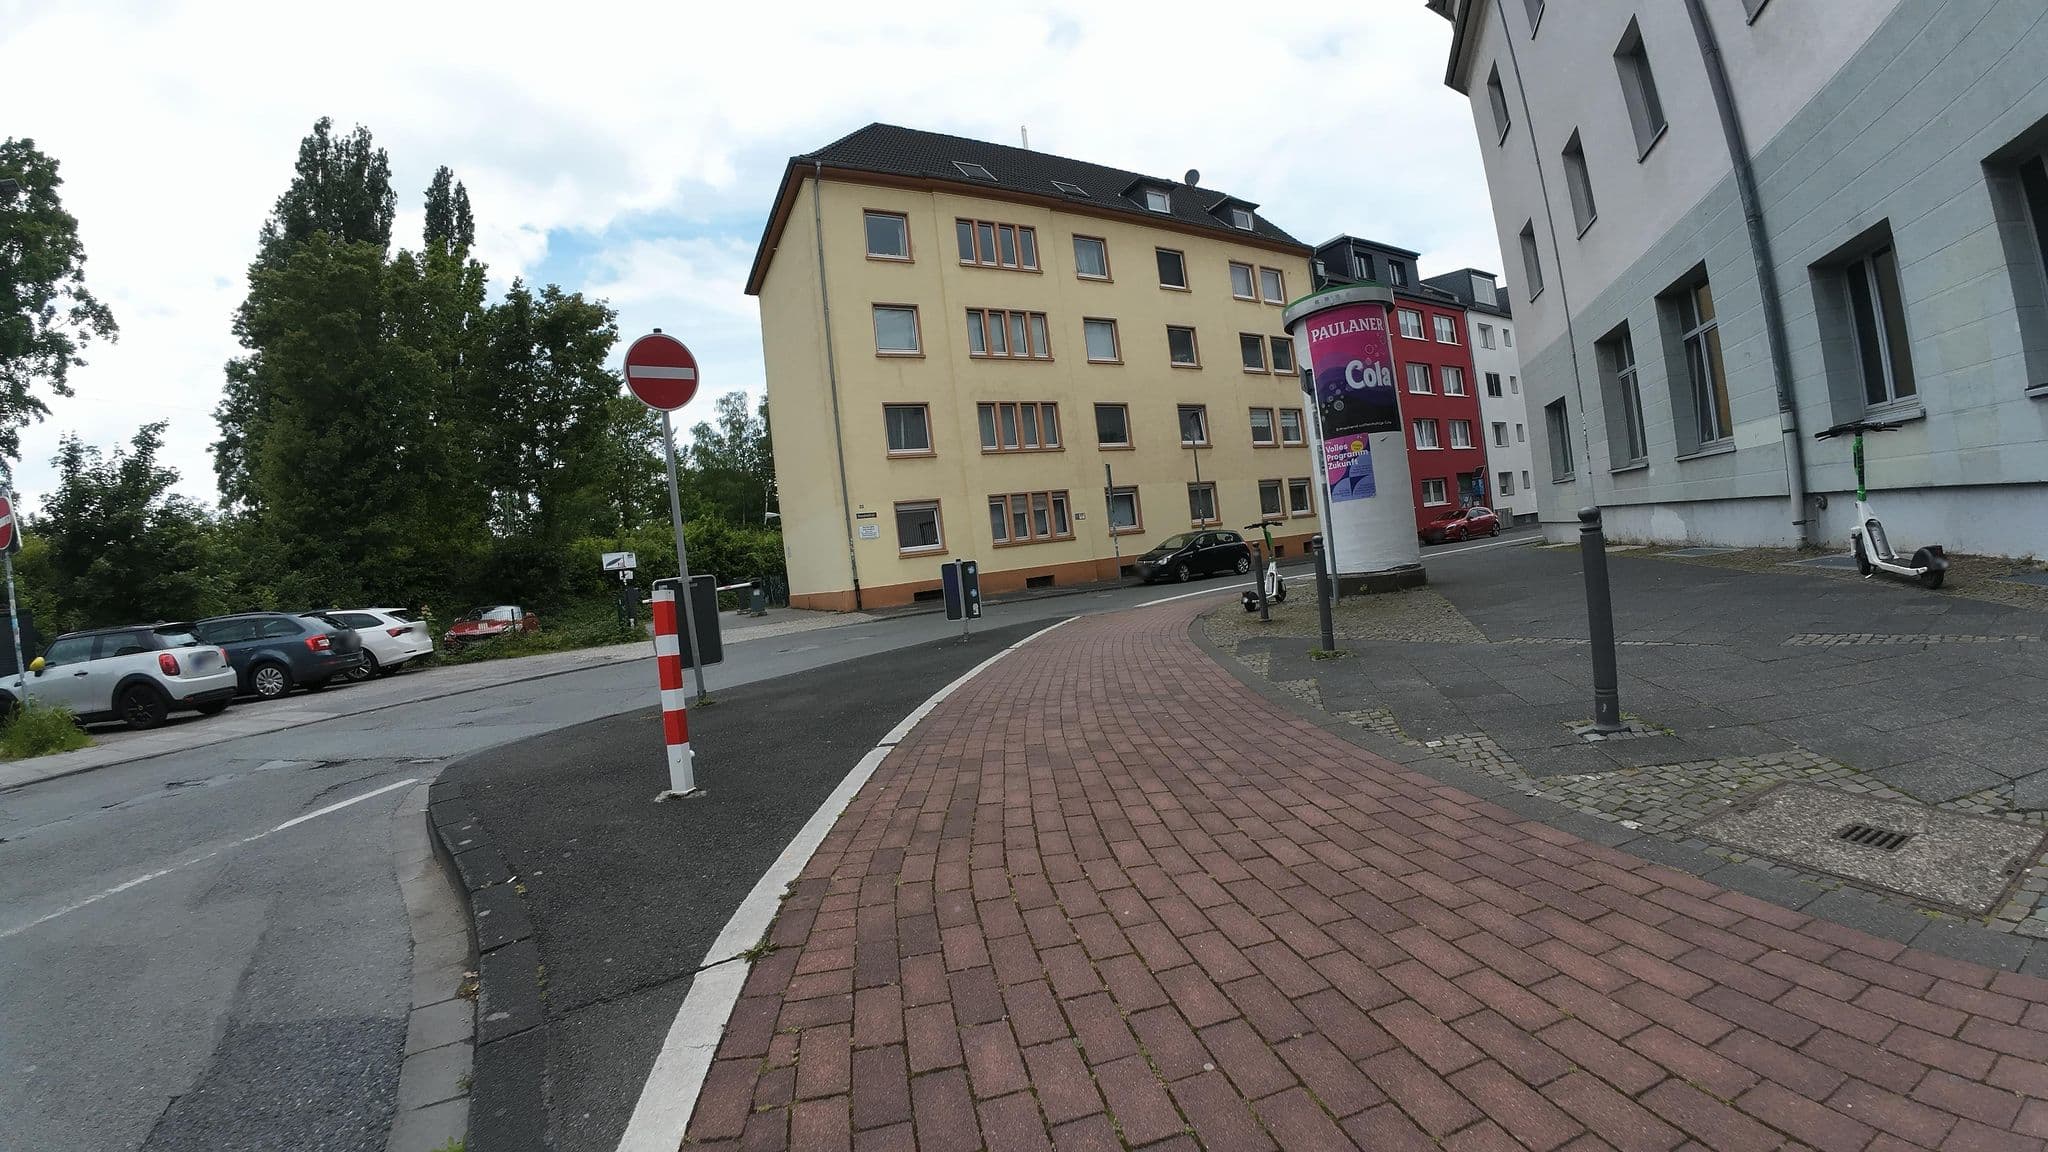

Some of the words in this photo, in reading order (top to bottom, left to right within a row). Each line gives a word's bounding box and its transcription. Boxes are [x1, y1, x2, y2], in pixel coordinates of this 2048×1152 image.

[1311, 317, 1384, 343] PAULANER
[1345, 360, 1391, 389] Cola
[1325, 444, 1348, 453] Volles
[1326, 449, 1369, 462] Programm
[1328, 458, 1359, 470] Zukunft
